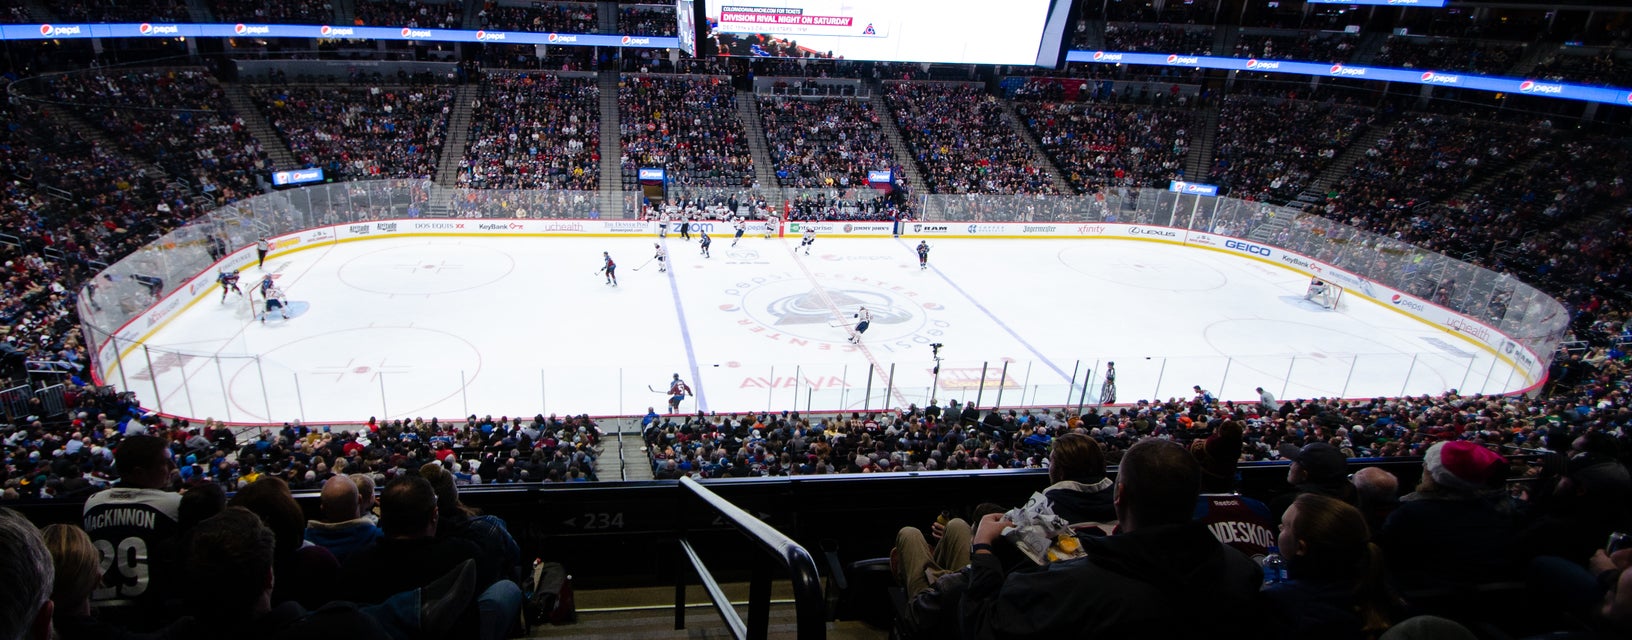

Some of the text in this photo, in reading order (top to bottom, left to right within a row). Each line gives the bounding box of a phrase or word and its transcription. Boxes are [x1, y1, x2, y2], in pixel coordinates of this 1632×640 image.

[723, 14, 850, 25] DIVISION RIVAL NIGHT ON SATURDAY
[54, 25, 81, 36] pepsi
[153, 24, 178, 35] pepsi
[246, 25, 269, 35] pepsi
[332, 27, 353, 37] pepsi
[411, 30, 431, 39] pepsi
[486, 32, 505, 41] pepsi
[558, 35, 577, 43] pepsi
[631, 37, 649, 46] pepsi
[1102, 52, 1122, 61] pepsi
[1177, 56, 1198, 65] pepsi
[1257, 61, 1279, 70] pepsi
[1341, 67, 1365, 76] pepsi
[1433, 74, 1457, 84] pepsi
[1533, 83, 1562, 94] pepsi
[479, 223, 508, 231] KeyBank
[545, 222, 584, 232] uchealth
[1077, 225, 1105, 234] xfinity
[1140, 229, 1176, 237] LEXUS
[1225, 239, 1271, 257] GEICO
[1282, 254, 1309, 269] KeyBank
[1401, 299, 1424, 312] pepsi
[1446, 316, 1491, 343] uchealth
[583, 512, 625, 529] 234
[91, 536, 149, 599] 29
